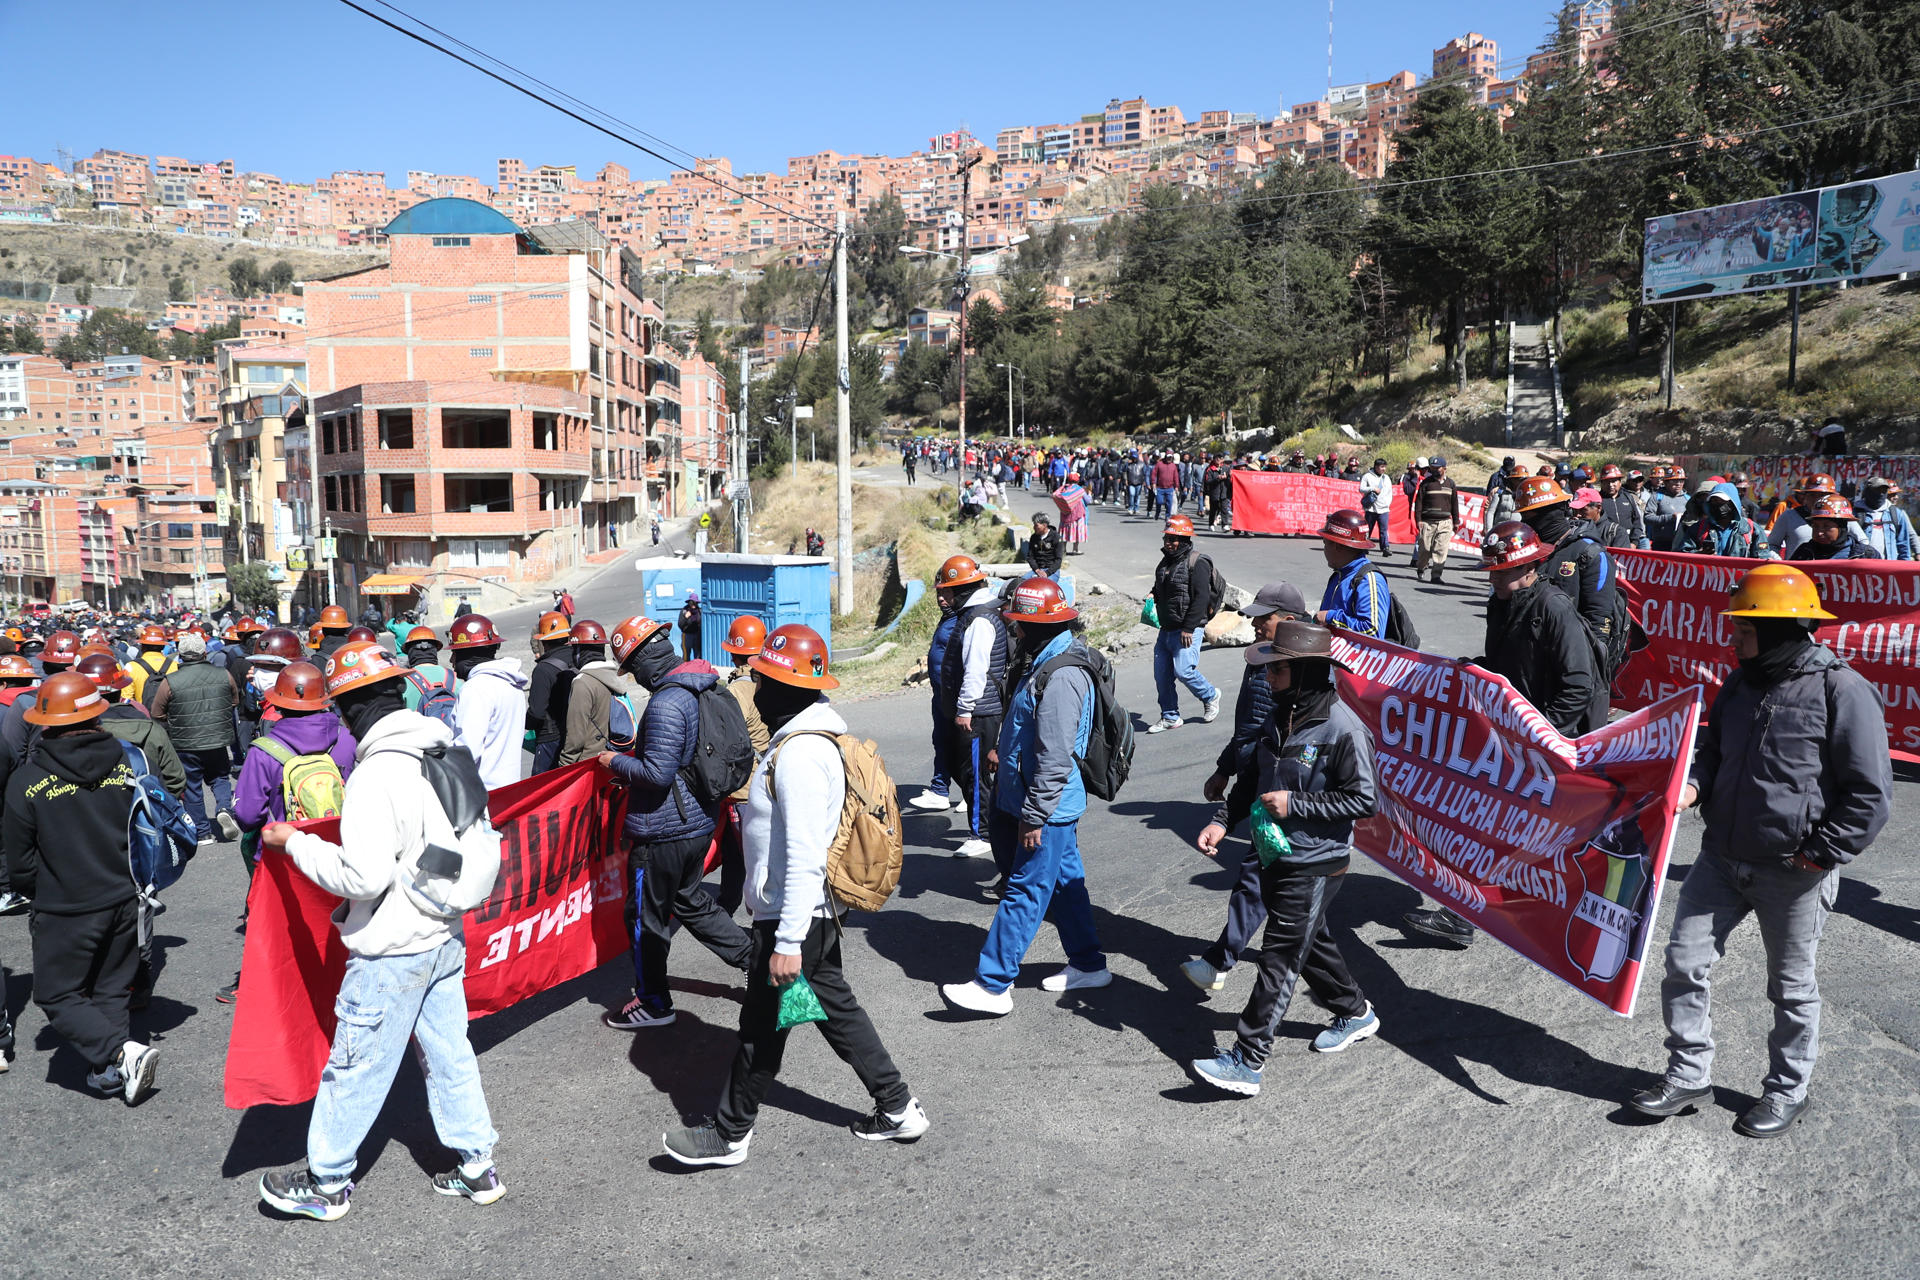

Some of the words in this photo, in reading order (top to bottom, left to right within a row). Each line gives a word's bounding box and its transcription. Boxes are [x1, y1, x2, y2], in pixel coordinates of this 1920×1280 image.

[1752, 456, 1815, 478] QUIERE
[1823, 457, 1920, 480] TRABAJAR
[1377, 656, 1433, 695] MIXTO
[1424, 664, 1455, 703] DE
[25, 778, 50, 798] Treat
[1380, 695, 1558, 807] CHILAYA
[1390, 761, 1424, 798] EN
[1412, 771, 1445, 809] LA
[1436, 783, 1502, 836] LUCHA
[1387, 829, 1405, 863] LA
[1432, 858, 1487, 914] BOLIVIA
[1415, 815, 1495, 880] MUNICIPIO
[1488, 855, 1568, 909] CAJUATA
